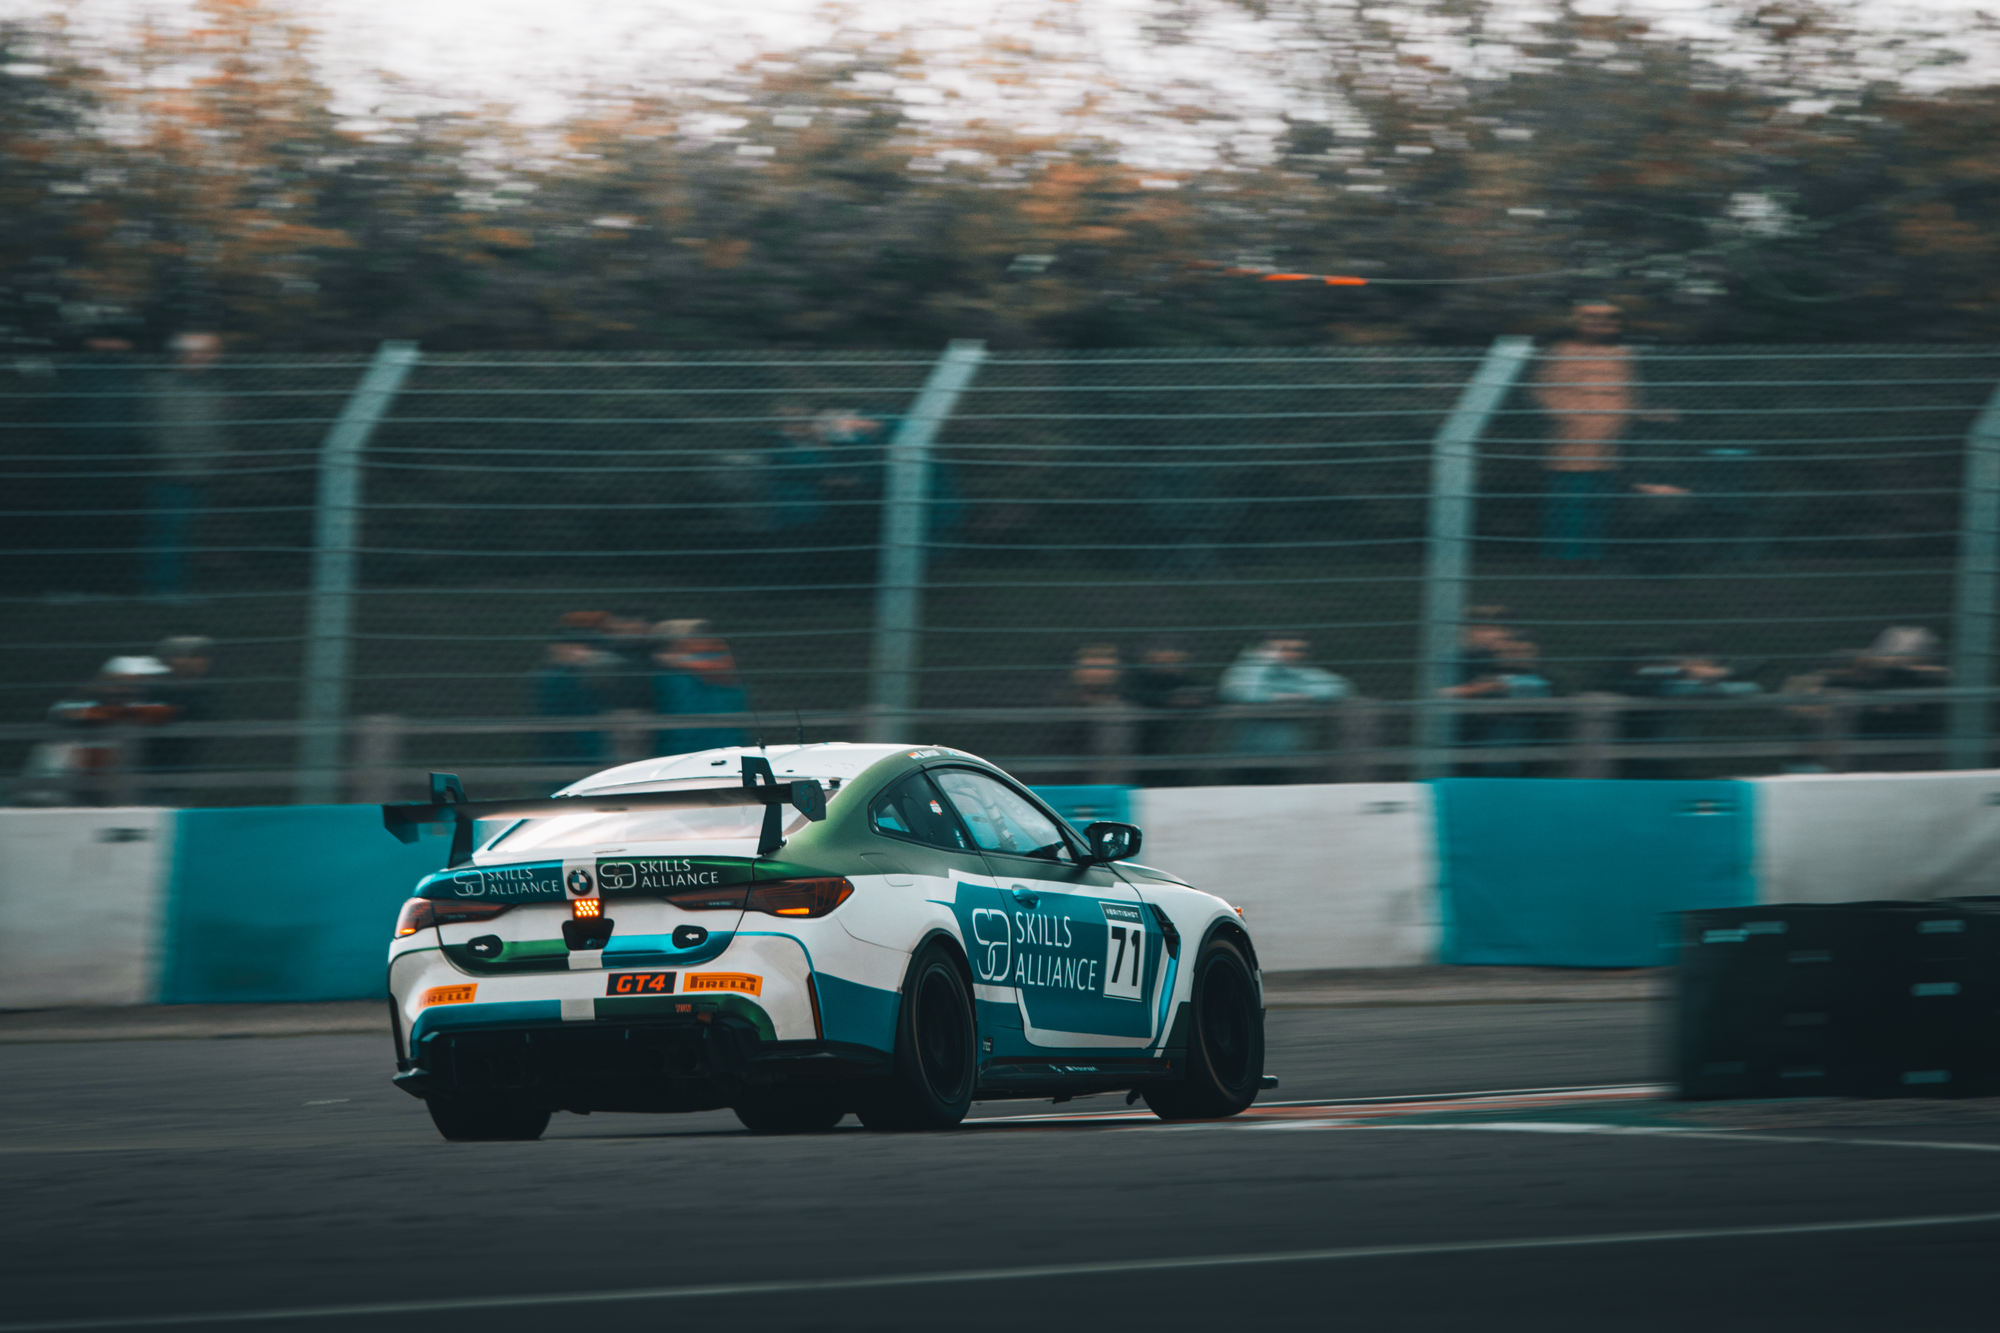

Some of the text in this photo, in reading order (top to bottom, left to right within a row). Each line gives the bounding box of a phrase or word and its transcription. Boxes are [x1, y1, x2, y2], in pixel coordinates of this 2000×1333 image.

[488, 867, 533, 881] SKILLS
[640, 859, 691, 874] SKILLS
[489, 881, 560, 895] ALLIANCE
[642, 872, 719, 888] ALLIANCE
[1015, 911, 1072, 948] SKILLS
[1111, 926, 1141, 987] 71
[1015, 953, 1098, 991] ALLIANCE
[616, 974, 666, 992] GT4
[690, 975, 757, 991] PIRELLI
[675, 1004, 692, 1012] TOW
